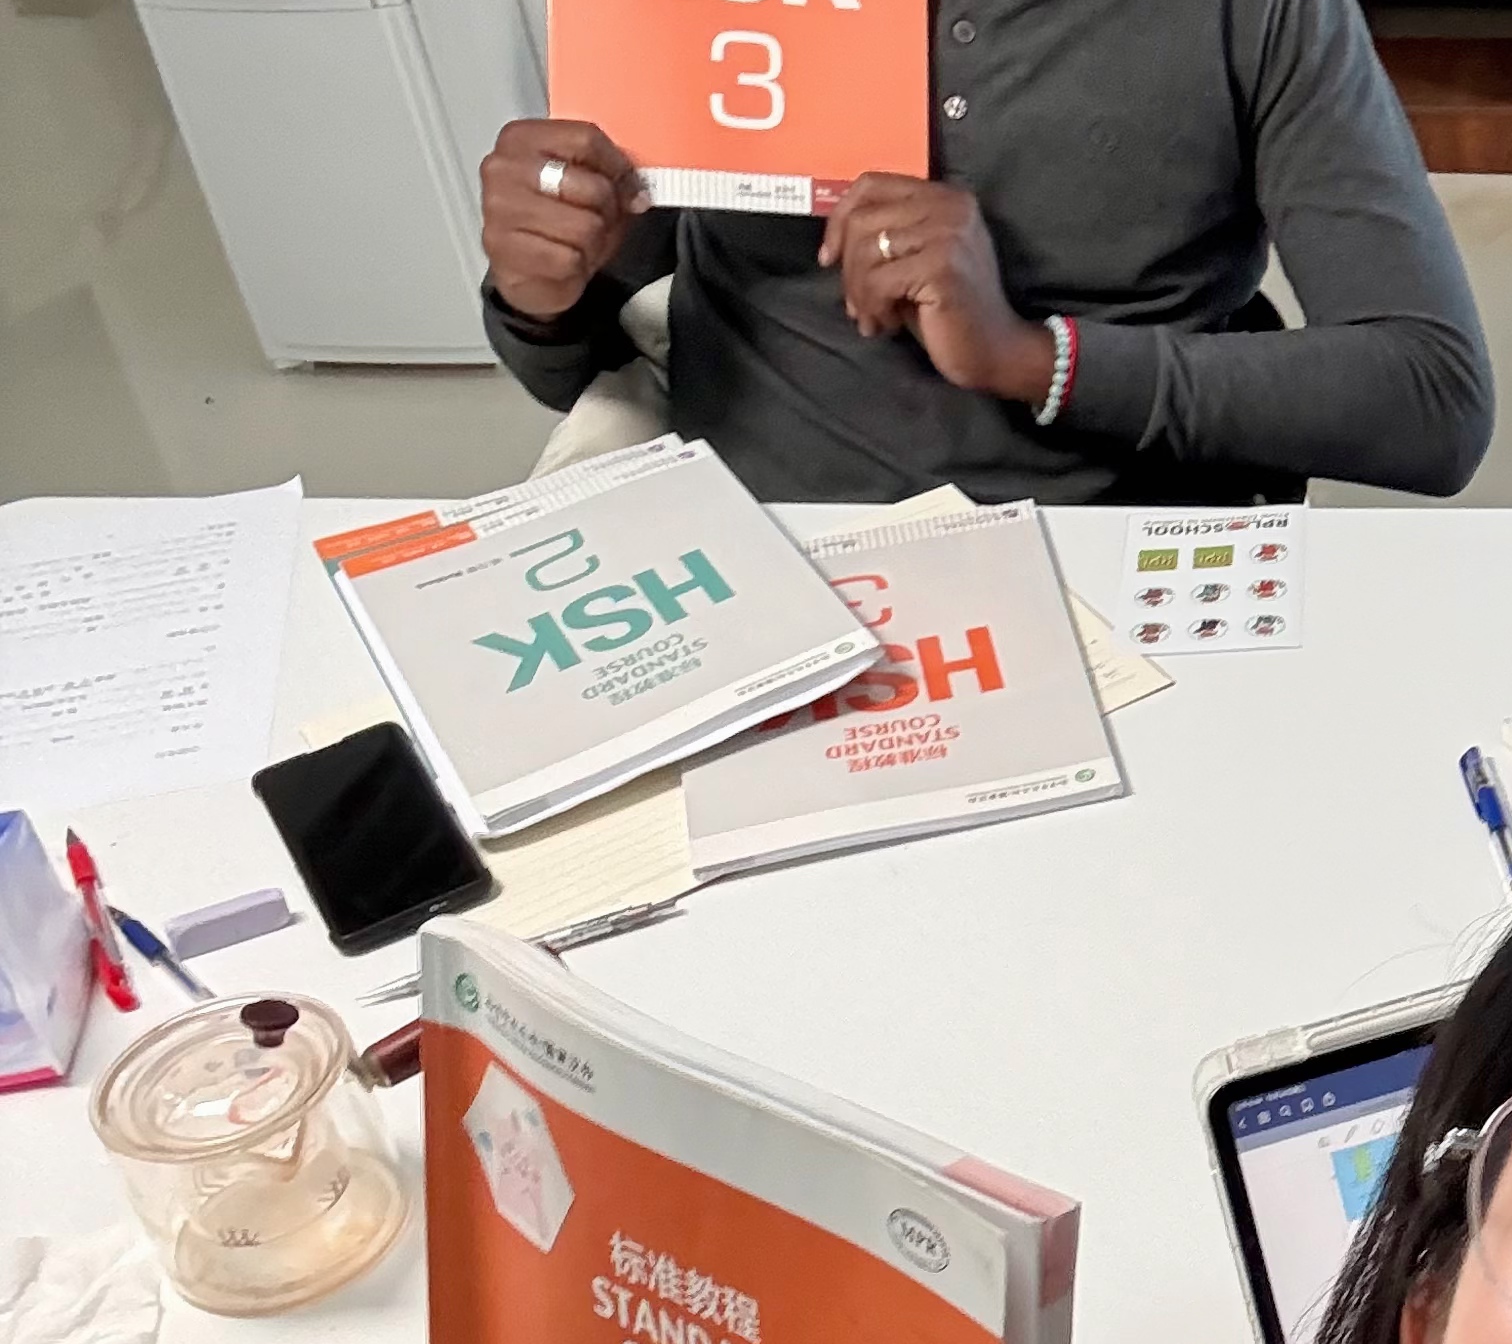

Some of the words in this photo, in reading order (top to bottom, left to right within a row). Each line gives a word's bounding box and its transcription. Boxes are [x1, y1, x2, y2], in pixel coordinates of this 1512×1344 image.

[708, 29, 786, 131] 3
[508, 527, 601, 593] 2
[472, 546, 738, 694] HSK
[581, 637, 709, 700] STANDARD
[592, 632, 685, 679] COURSE
[825, 724, 961, 759] STANDARD
[843, 714, 941, 741] COURSE
[609, 1229, 762, 1344] 标准教程
